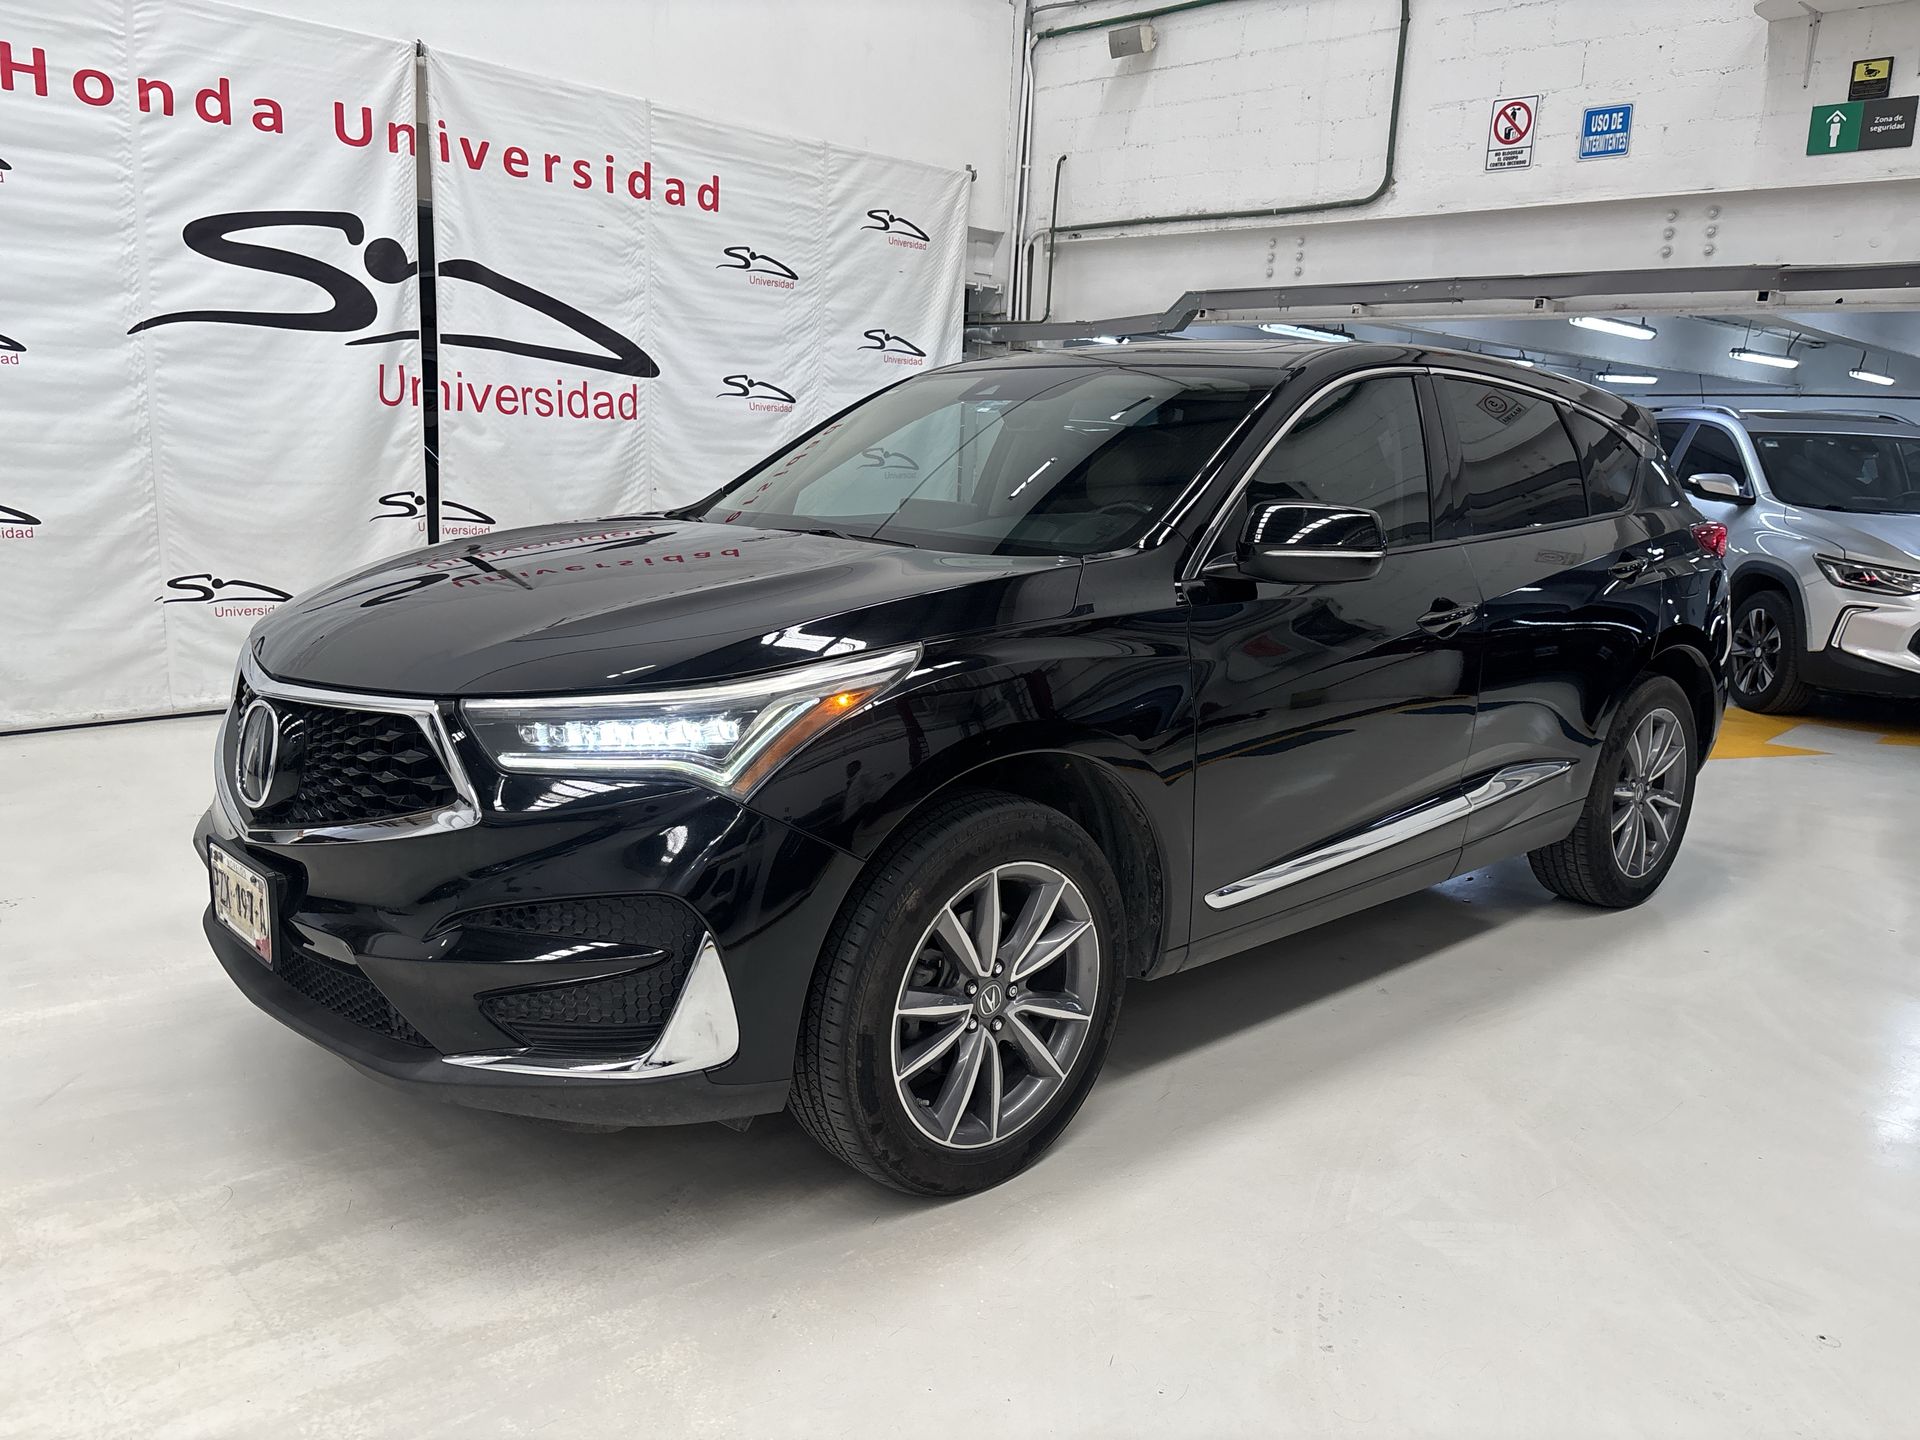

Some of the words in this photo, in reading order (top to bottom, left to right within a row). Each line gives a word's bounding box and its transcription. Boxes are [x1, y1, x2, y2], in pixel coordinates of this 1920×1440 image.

[1591, 114, 1609, 133] USO
[1611, 112, 1624, 131] DE
[1874, 116, 1893, 124] Zona
[1894, 114, 1904, 122] de
[0, 41, 284, 133] Honda
[333, 101, 721, 213] Universidad
[1870, 122, 1906, 133] seguridad
[888, 236, 927, 251] Universidad
[749, 276, 795, 290] Universidad
[883, 355, 923, 366] Universidad
[378, 363, 638, 421] Universidad
[749, 402, 793, 413] Universidad
[418, 521, 491, 536] Uiversidad
